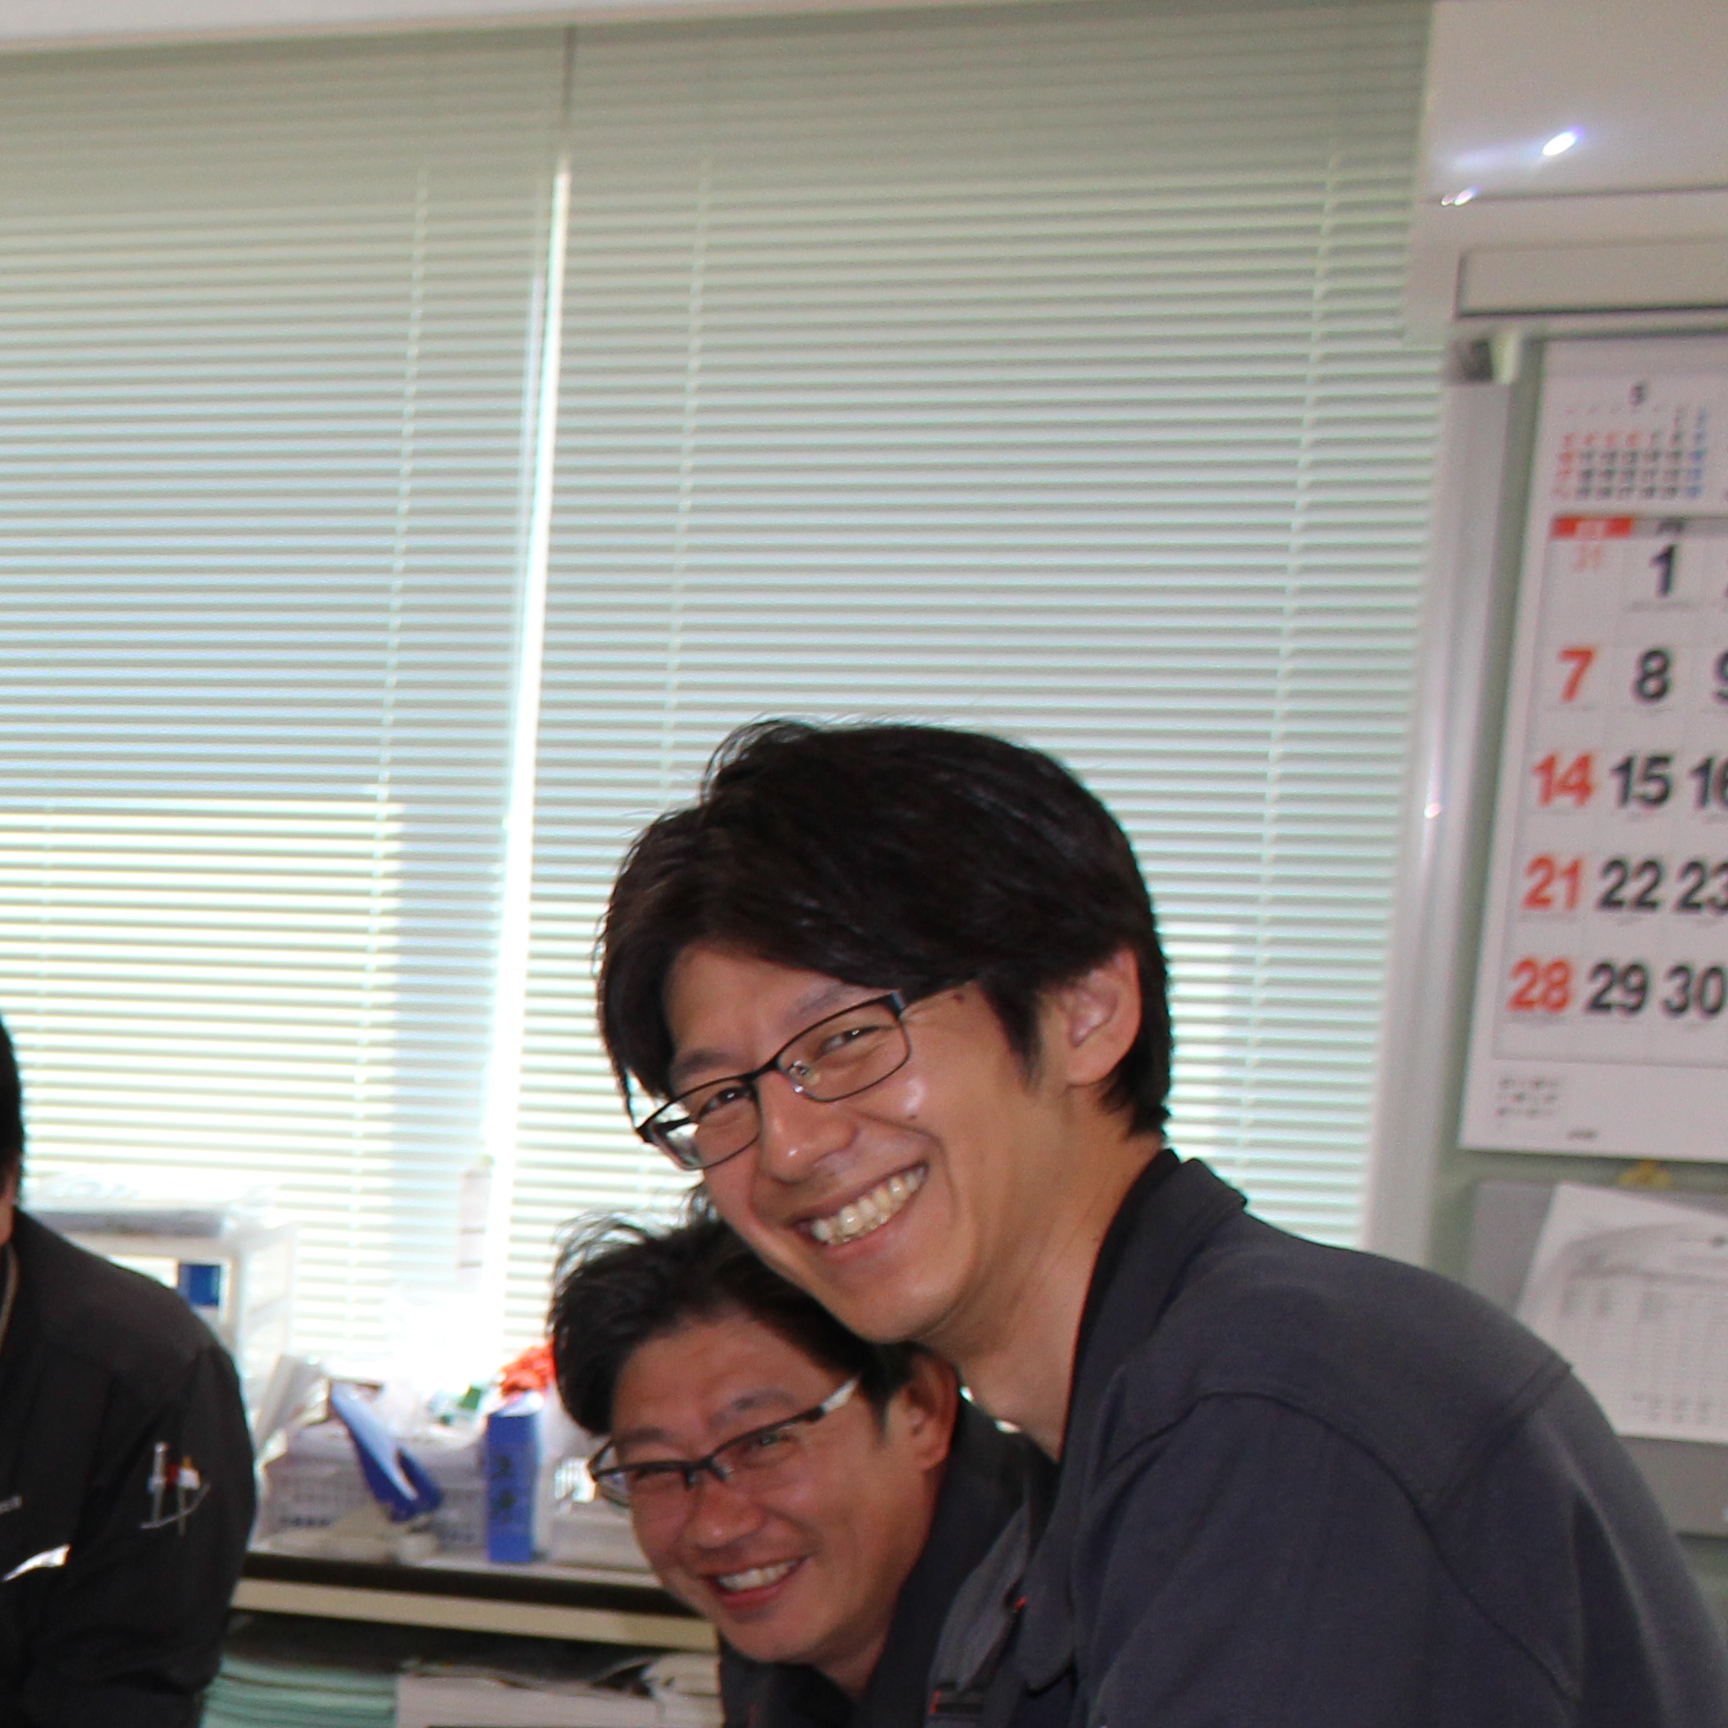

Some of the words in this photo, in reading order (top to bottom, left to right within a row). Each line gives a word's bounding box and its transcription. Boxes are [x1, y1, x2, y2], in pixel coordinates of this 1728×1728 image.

[1649, 543, 1678, 597] 1
[1557, 648, 1597, 702] 7
[1632, 648, 1673, 703] 8
[1531, 753, 1595, 807] 14
[1611, 754, 1675, 808] 15
[1690, 755, 1728, 808] 16
[1522, 857, 1585, 911] 21
[1596, 859, 1663, 912] 22
[1675, 863, 1728, 914] 23
[1509, 958, 1575, 1014] 28
[1585, 963, 1651, 1017] 29
[1663, 965, 1727, 1018] 30
